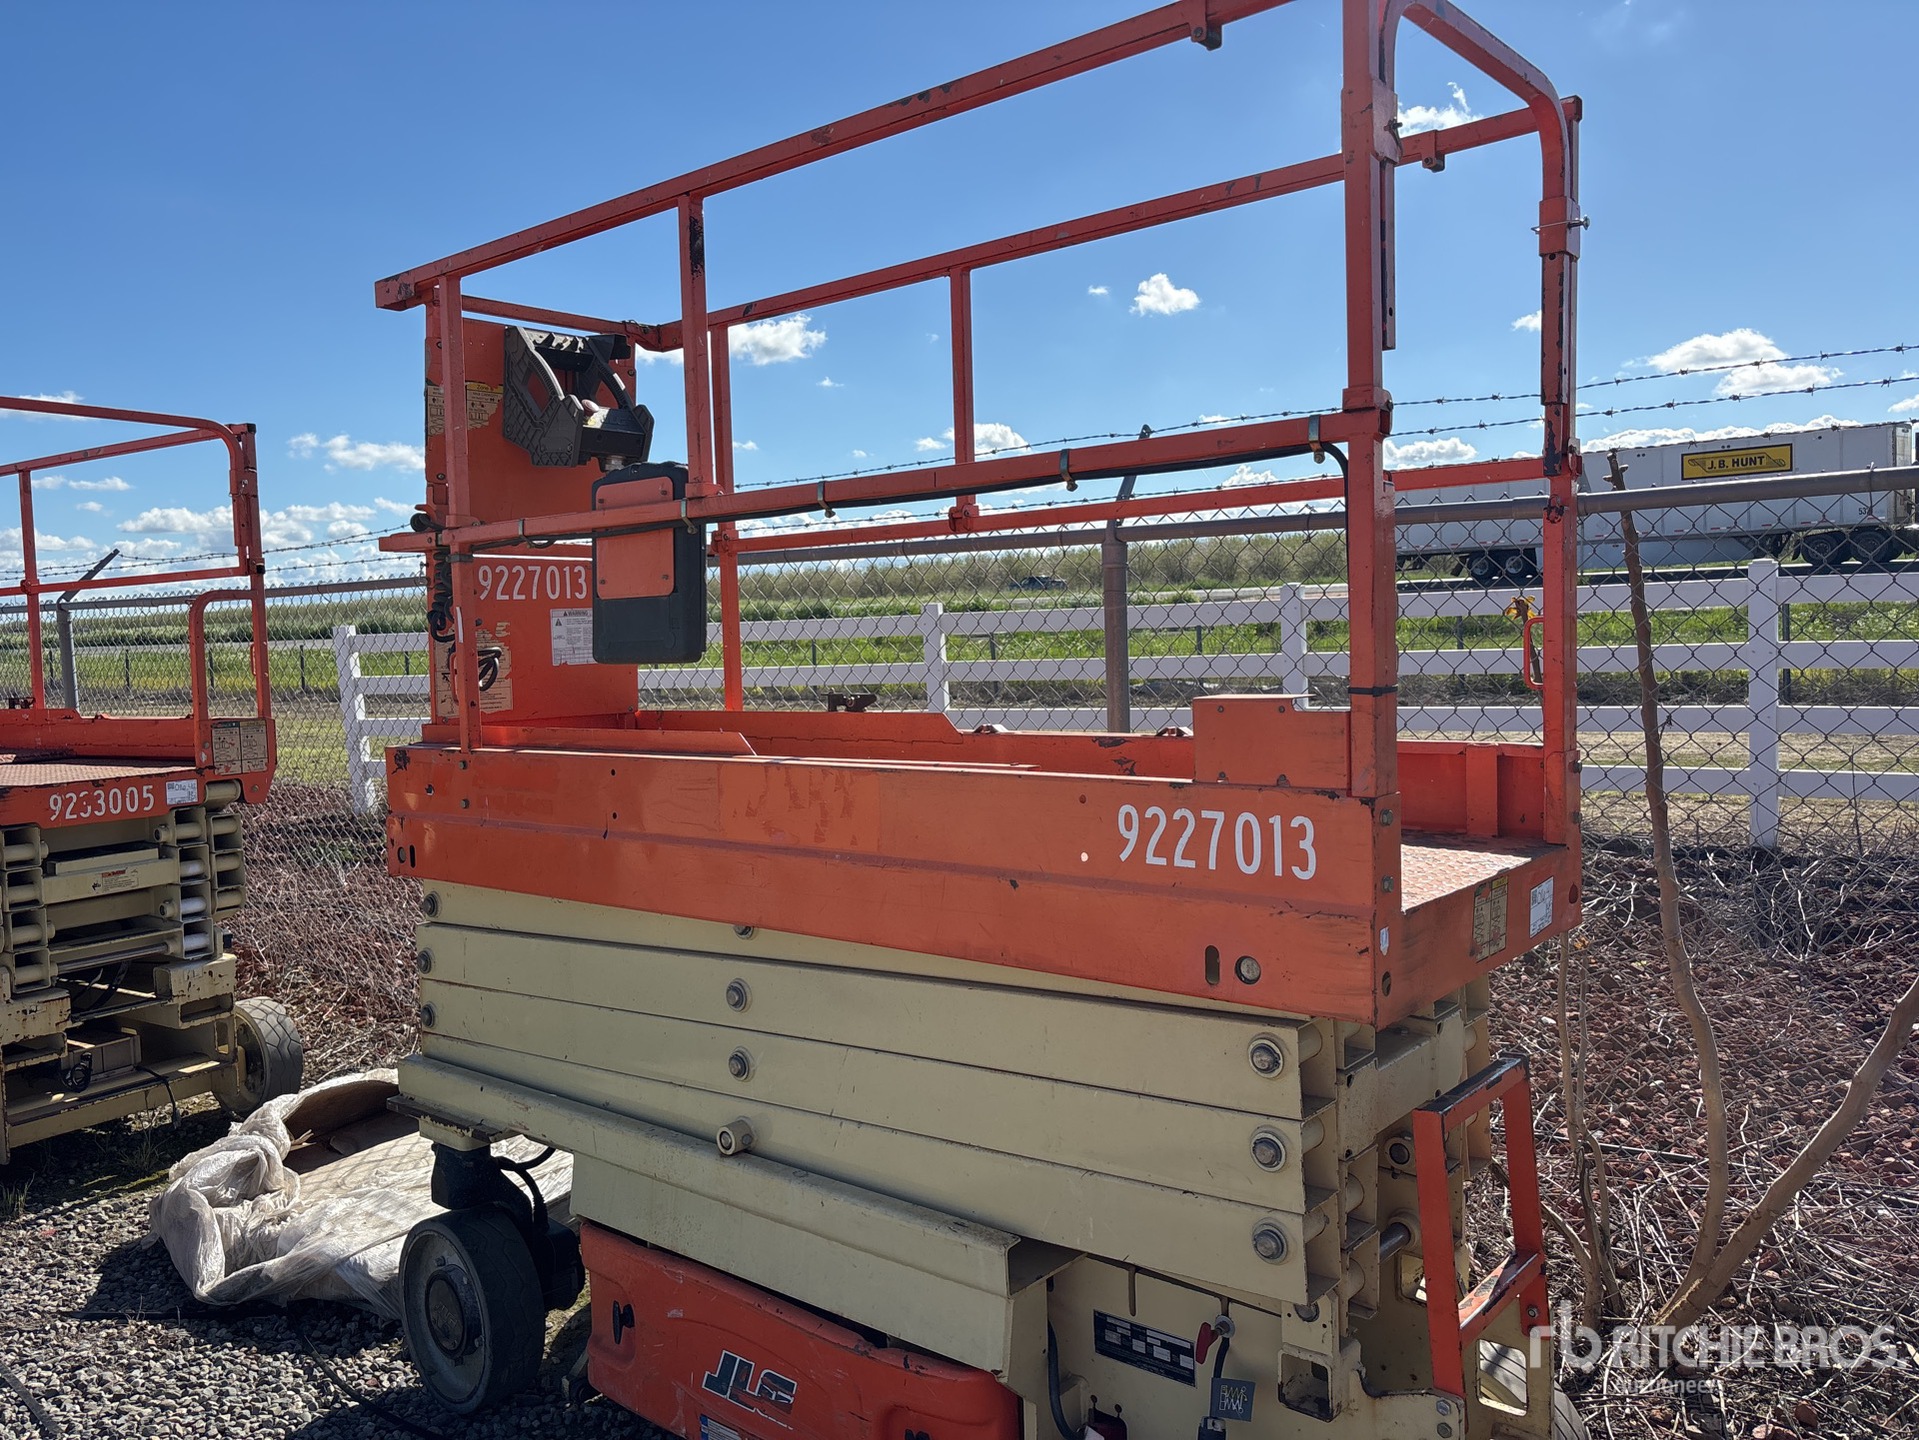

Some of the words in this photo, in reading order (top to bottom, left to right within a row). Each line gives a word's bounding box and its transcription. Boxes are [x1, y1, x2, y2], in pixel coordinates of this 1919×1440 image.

[1731, 455, 1765, 468] HUNT
[478, 565, 588, 600] 9227013
[1117, 804, 1317, 880] 9227013
